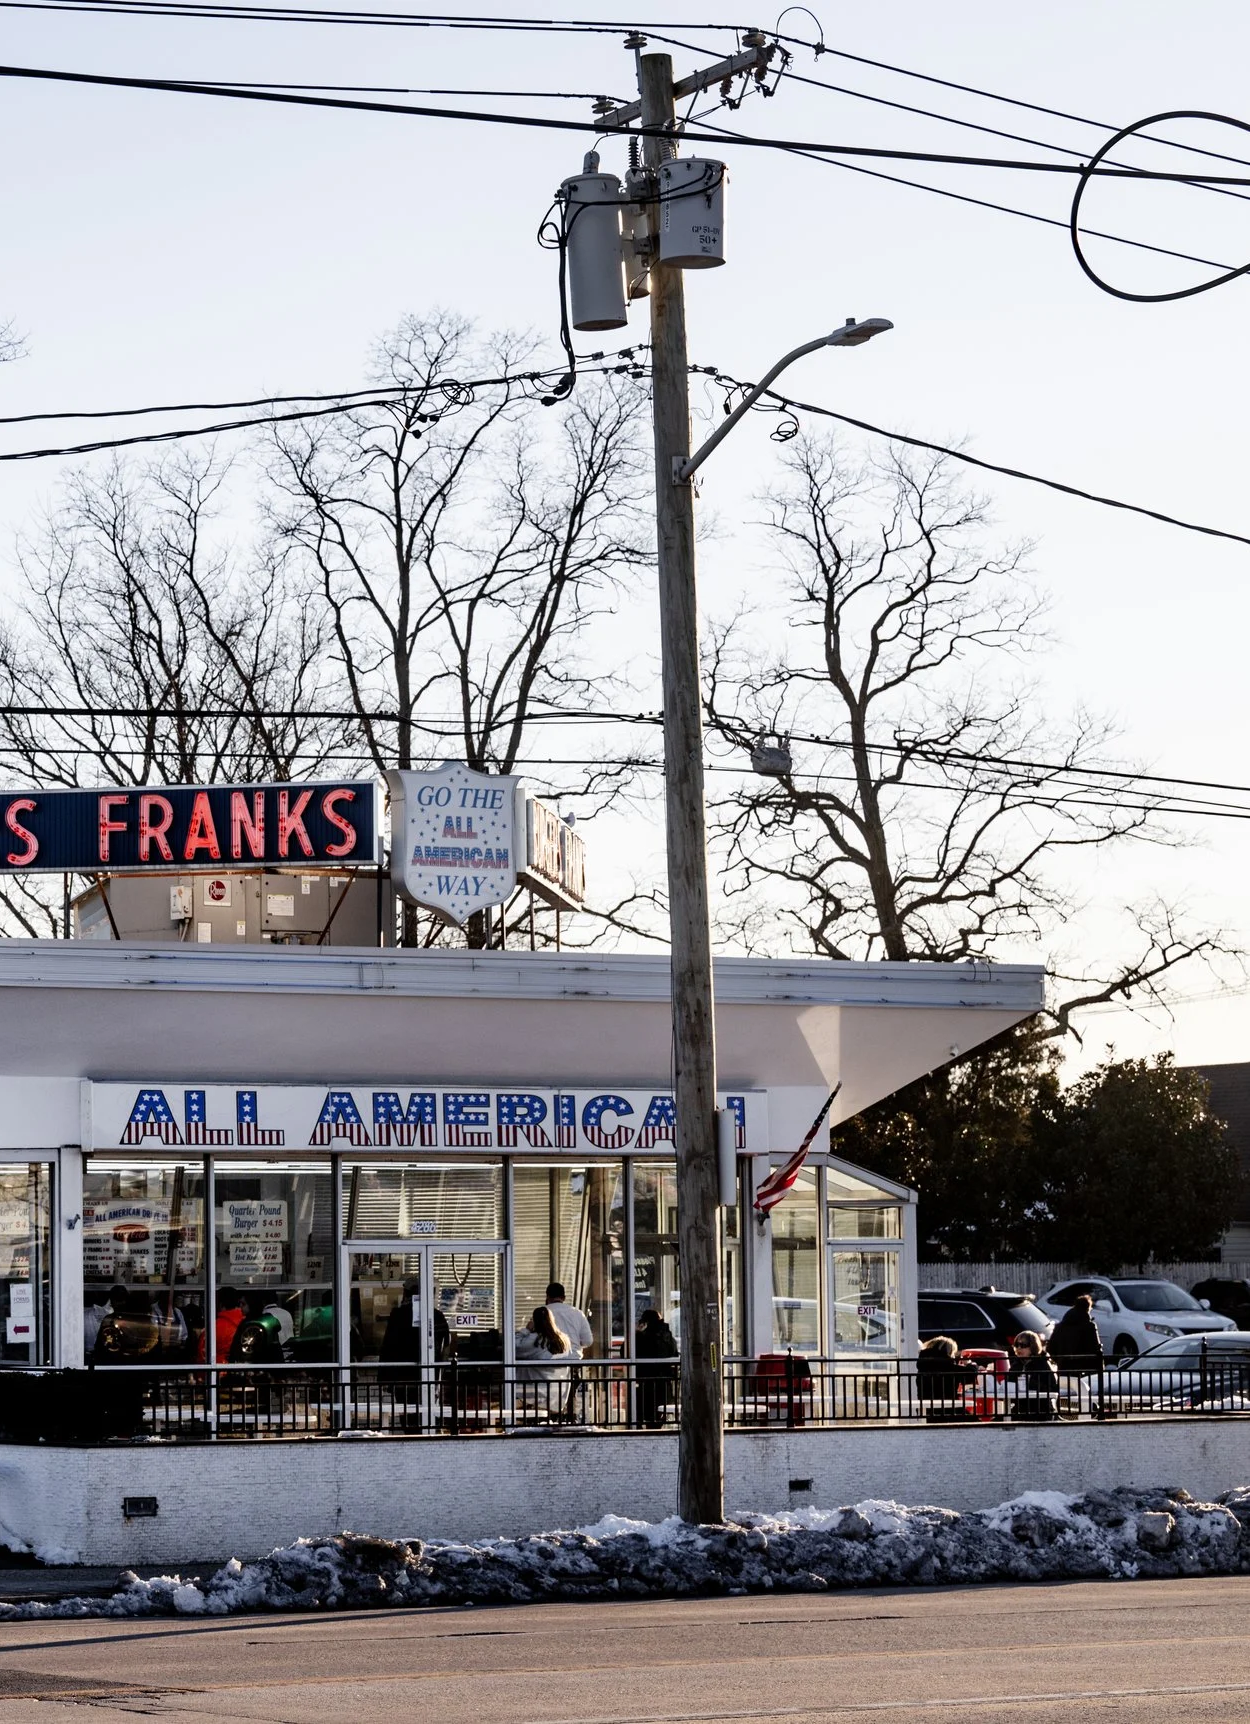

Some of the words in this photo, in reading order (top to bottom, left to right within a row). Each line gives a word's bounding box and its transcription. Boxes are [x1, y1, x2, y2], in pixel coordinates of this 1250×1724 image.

[417, 785, 451, 807] GO
[458, 787, 505, 810] THE
[99, 788, 358, 863] FRANKS
[441, 816, 479, 840] ALL
[411, 845, 509, 869] AMERICAN
[436, 875, 487, 896] WAY
[119, 1089, 286, 1146] ALL
[95, 1213, 107, 1222] ALL
[108, 1207, 141, 1220] AMERICAN
[229, 1205, 255, 1217] Quarter
[259, 1204, 282, 1216] Pound
[234, 1217, 258, 1231] Burger
[456, 1315, 477, 1325] EXIT
[857, 1306, 877, 1315] EXIT
